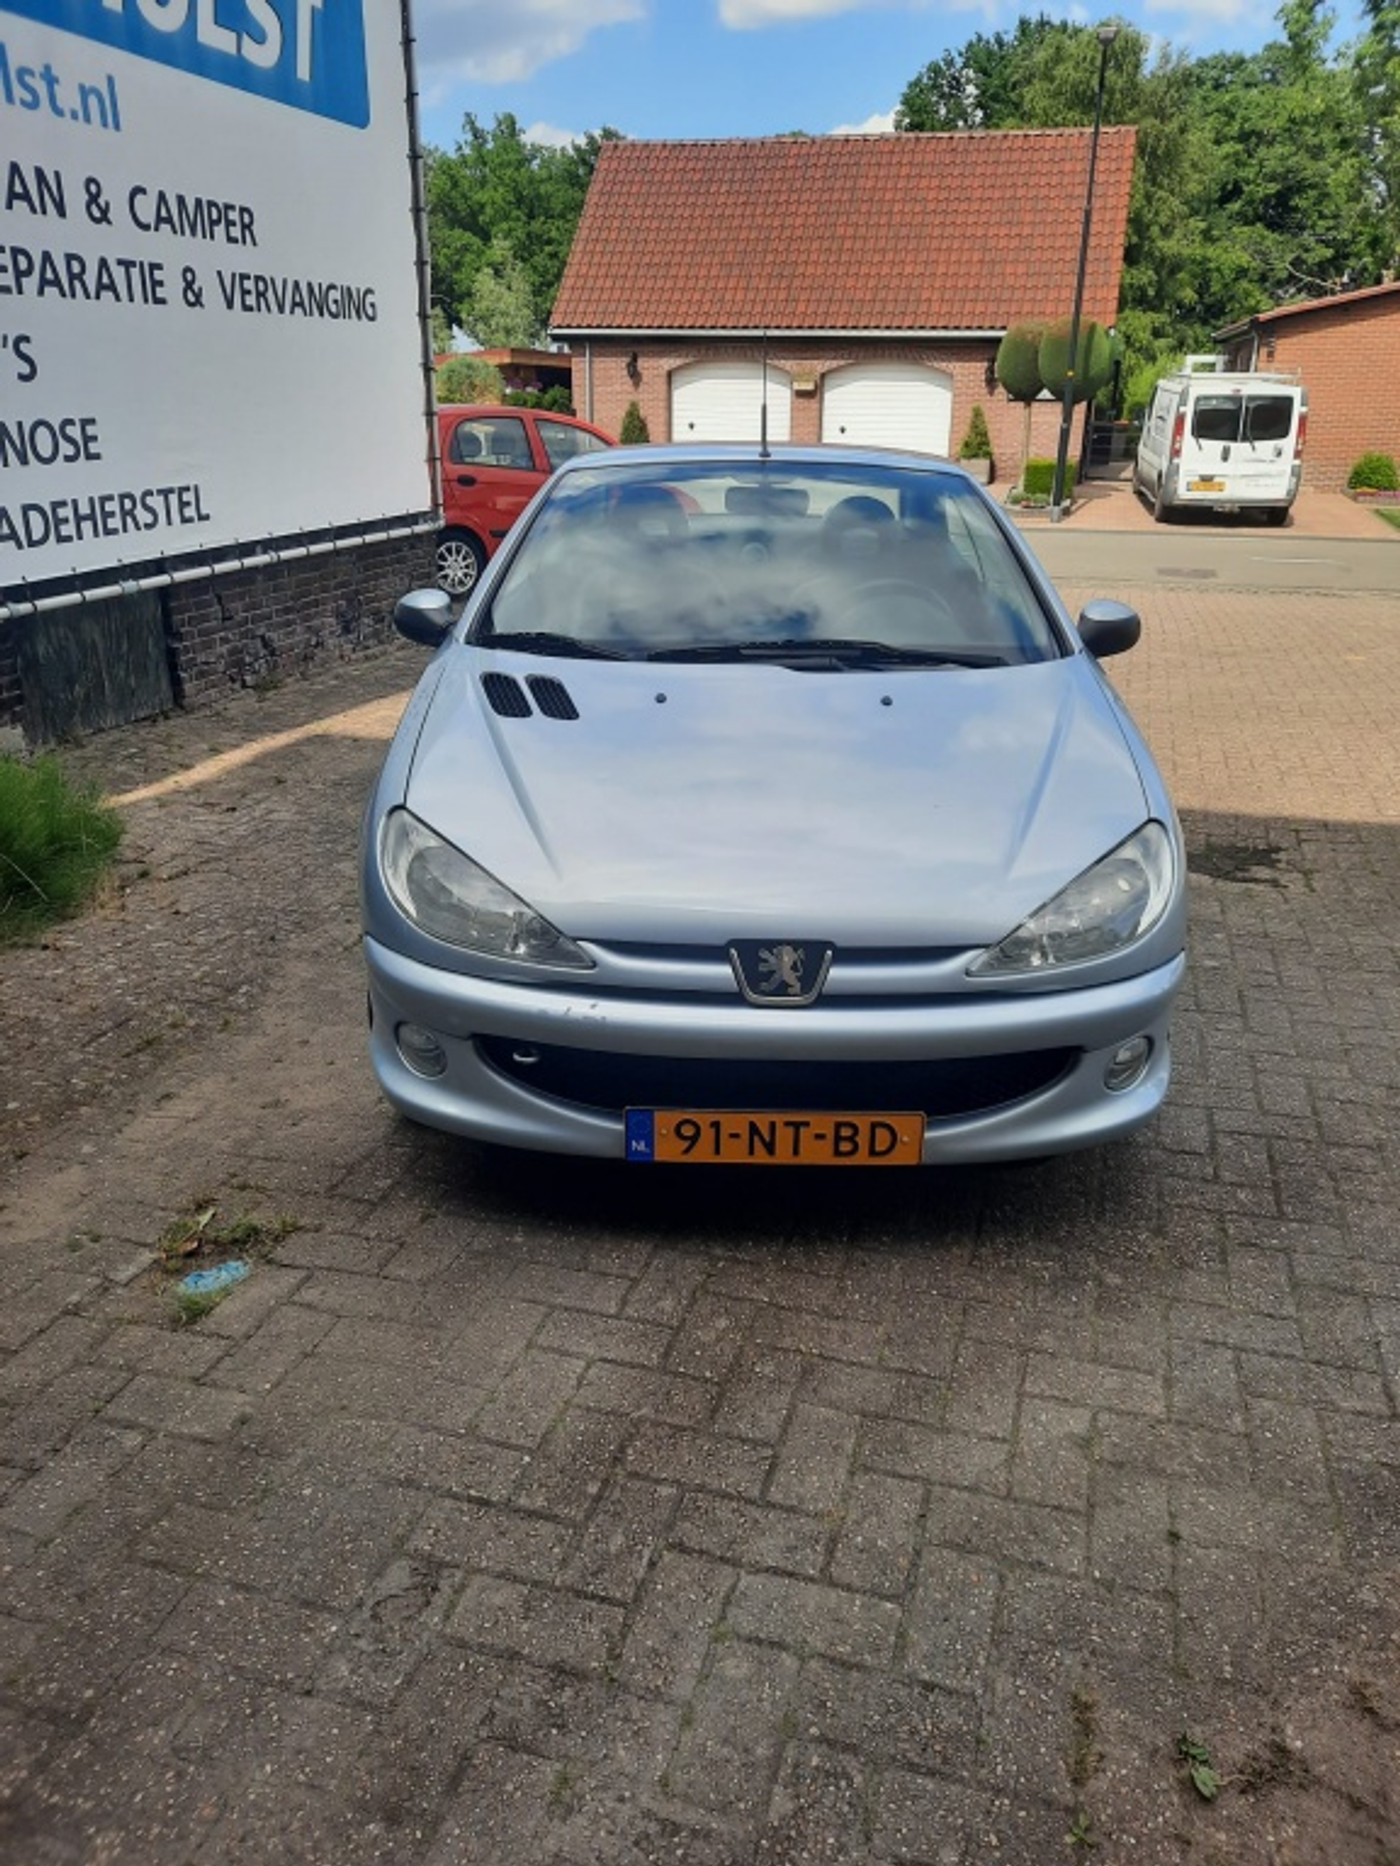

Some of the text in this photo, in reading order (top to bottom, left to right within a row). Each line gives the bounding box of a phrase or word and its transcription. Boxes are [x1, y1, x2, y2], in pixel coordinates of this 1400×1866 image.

[5, 160, 257, 247] AN & CAMPER
[181, 266, 204, 308] &
[216, 269, 377, 322] VERVANGING
[0, 417, 102, 468] NOSE
[0, 484, 210, 550] ADEHERSTEL
[631, 1118, 898, 1158] NL 91-NT-BD
